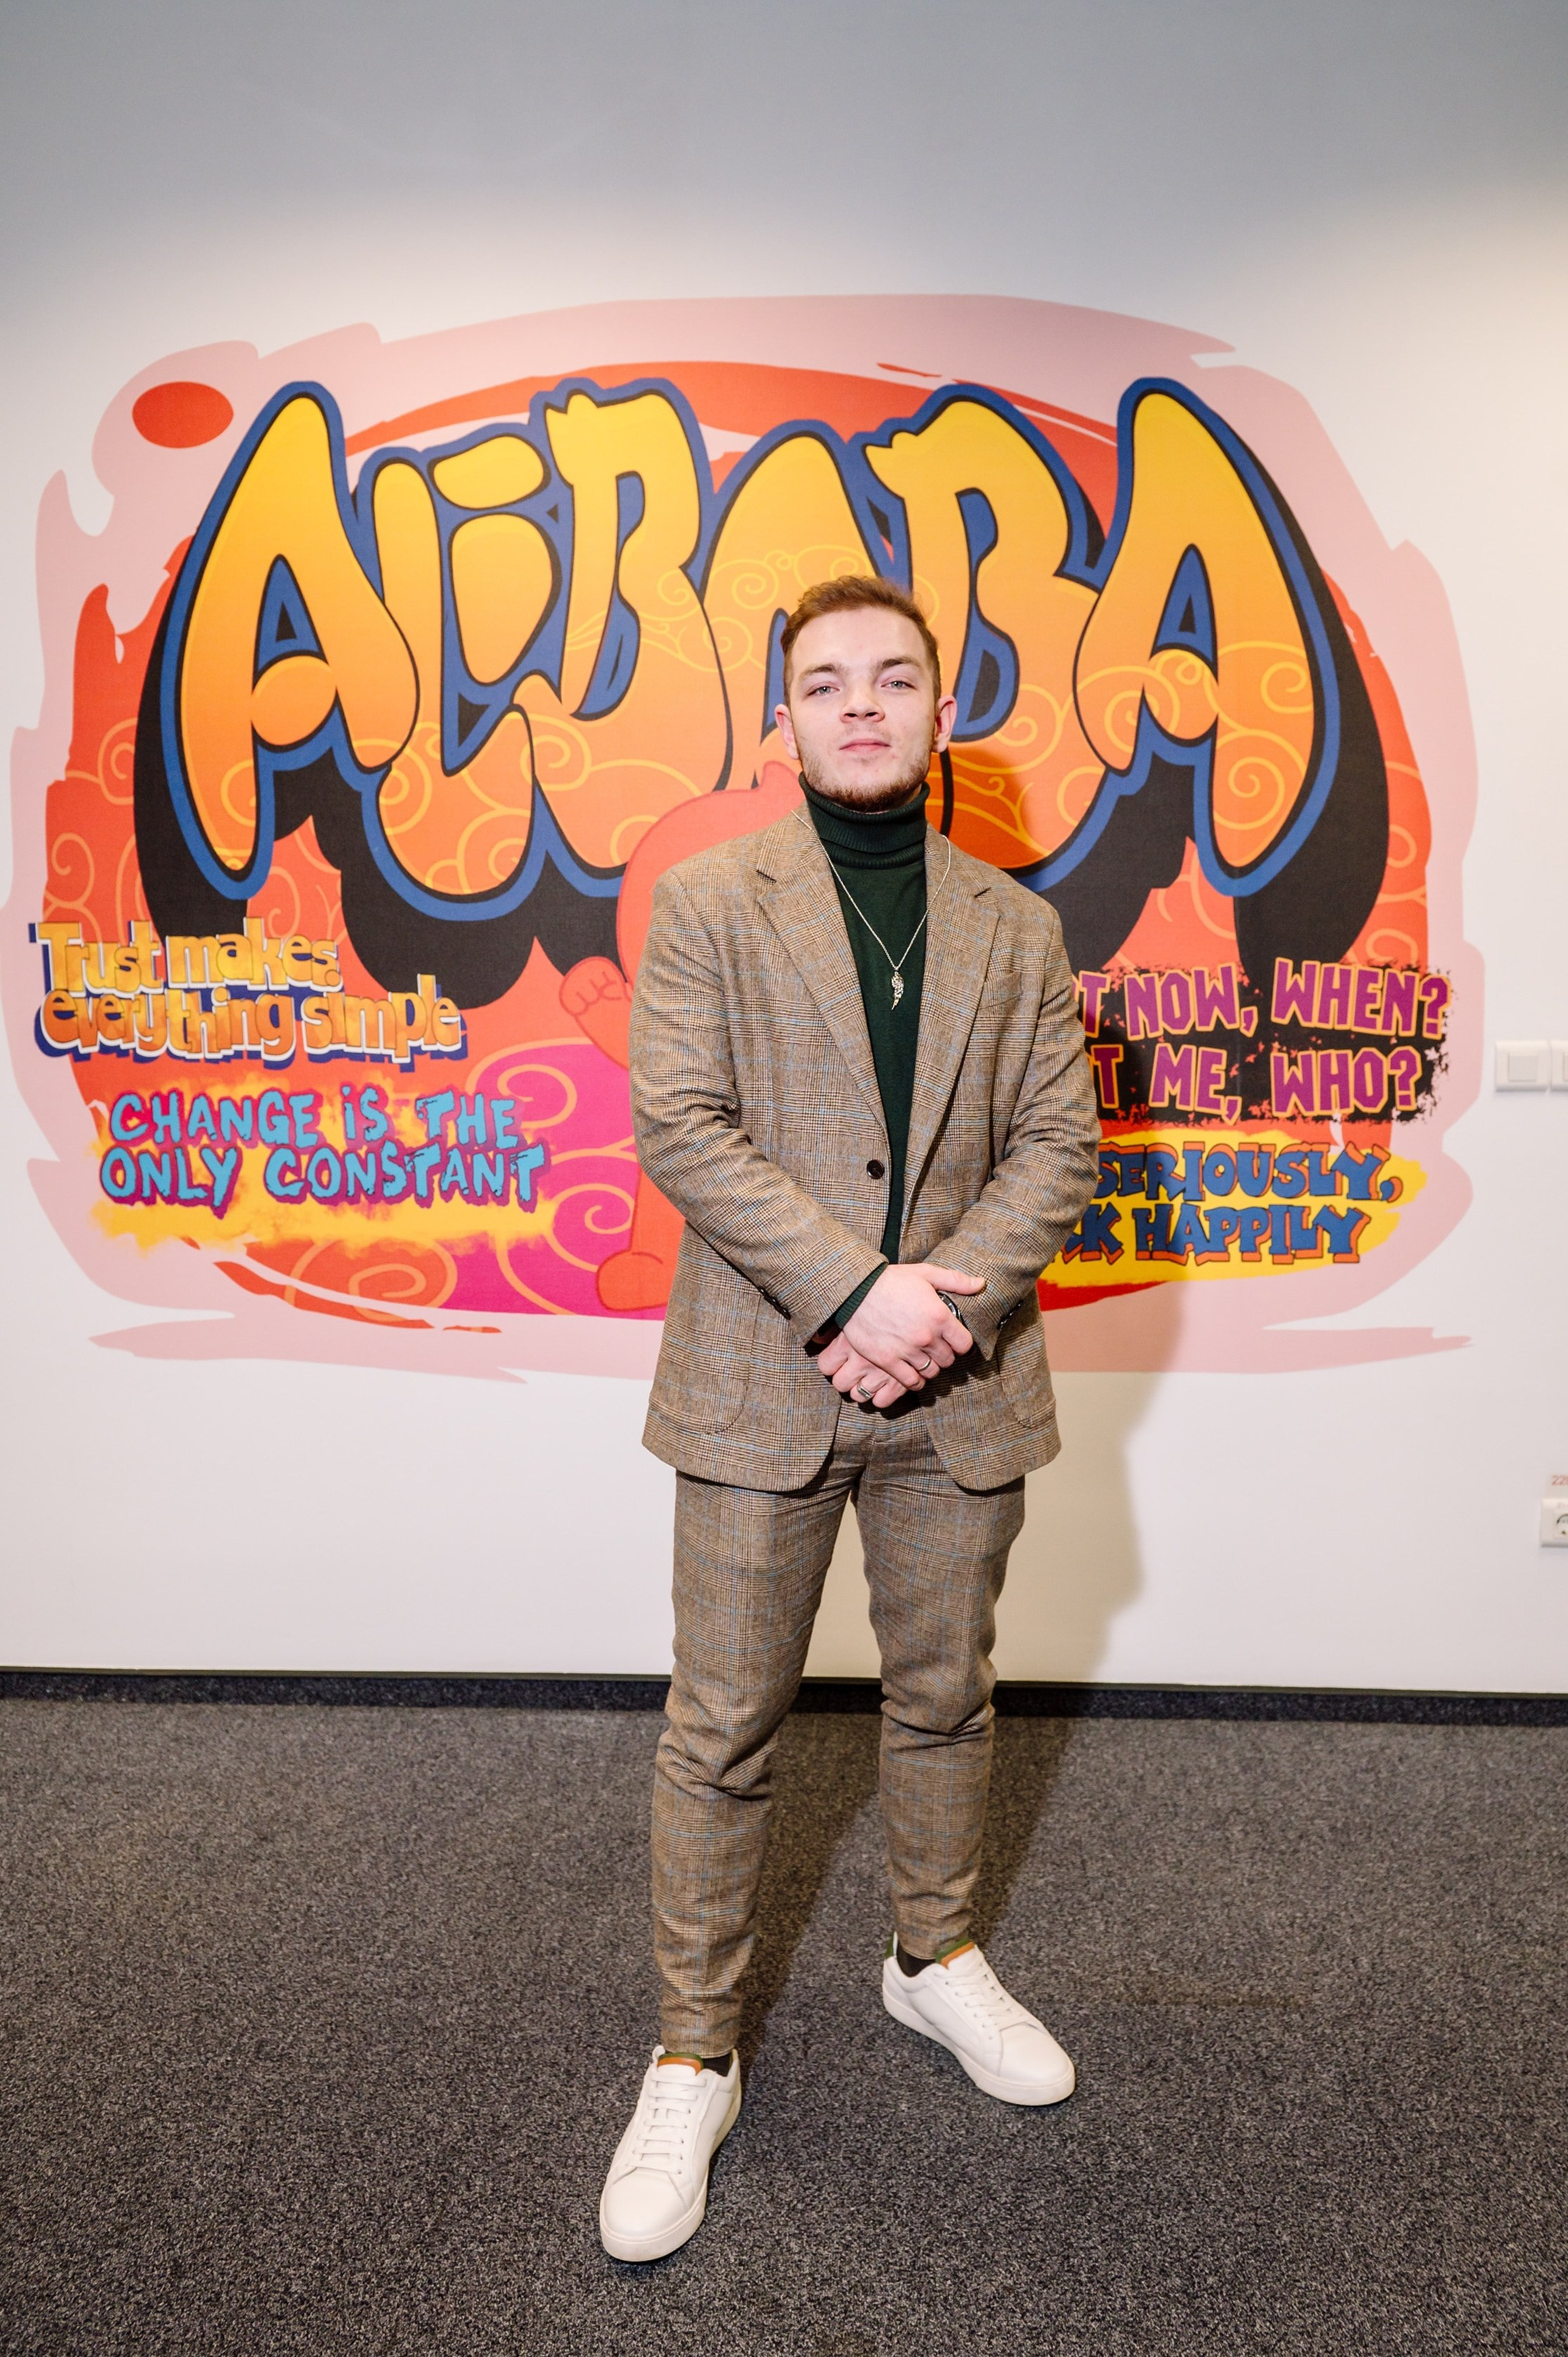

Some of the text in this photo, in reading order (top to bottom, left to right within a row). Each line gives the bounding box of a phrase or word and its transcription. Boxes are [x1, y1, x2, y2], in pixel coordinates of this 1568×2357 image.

[35, 919, 163, 997] Trust
[40, 973, 462, 1064] everything simple
[1124, 962, 1258, 1040] NOW,
[1271, 957, 1451, 1040] WHEN?
[110, 1090, 319, 1149] CHANGE
[415, 1089, 519, 1149] THE
[1148, 1043, 1242, 1125] ME,
[1270, 1045, 1423, 1117] WHO?
[101, 1139, 545, 1208] ONLY CONSTANT
[1132, 1201, 1371, 1265] HAPPILY
